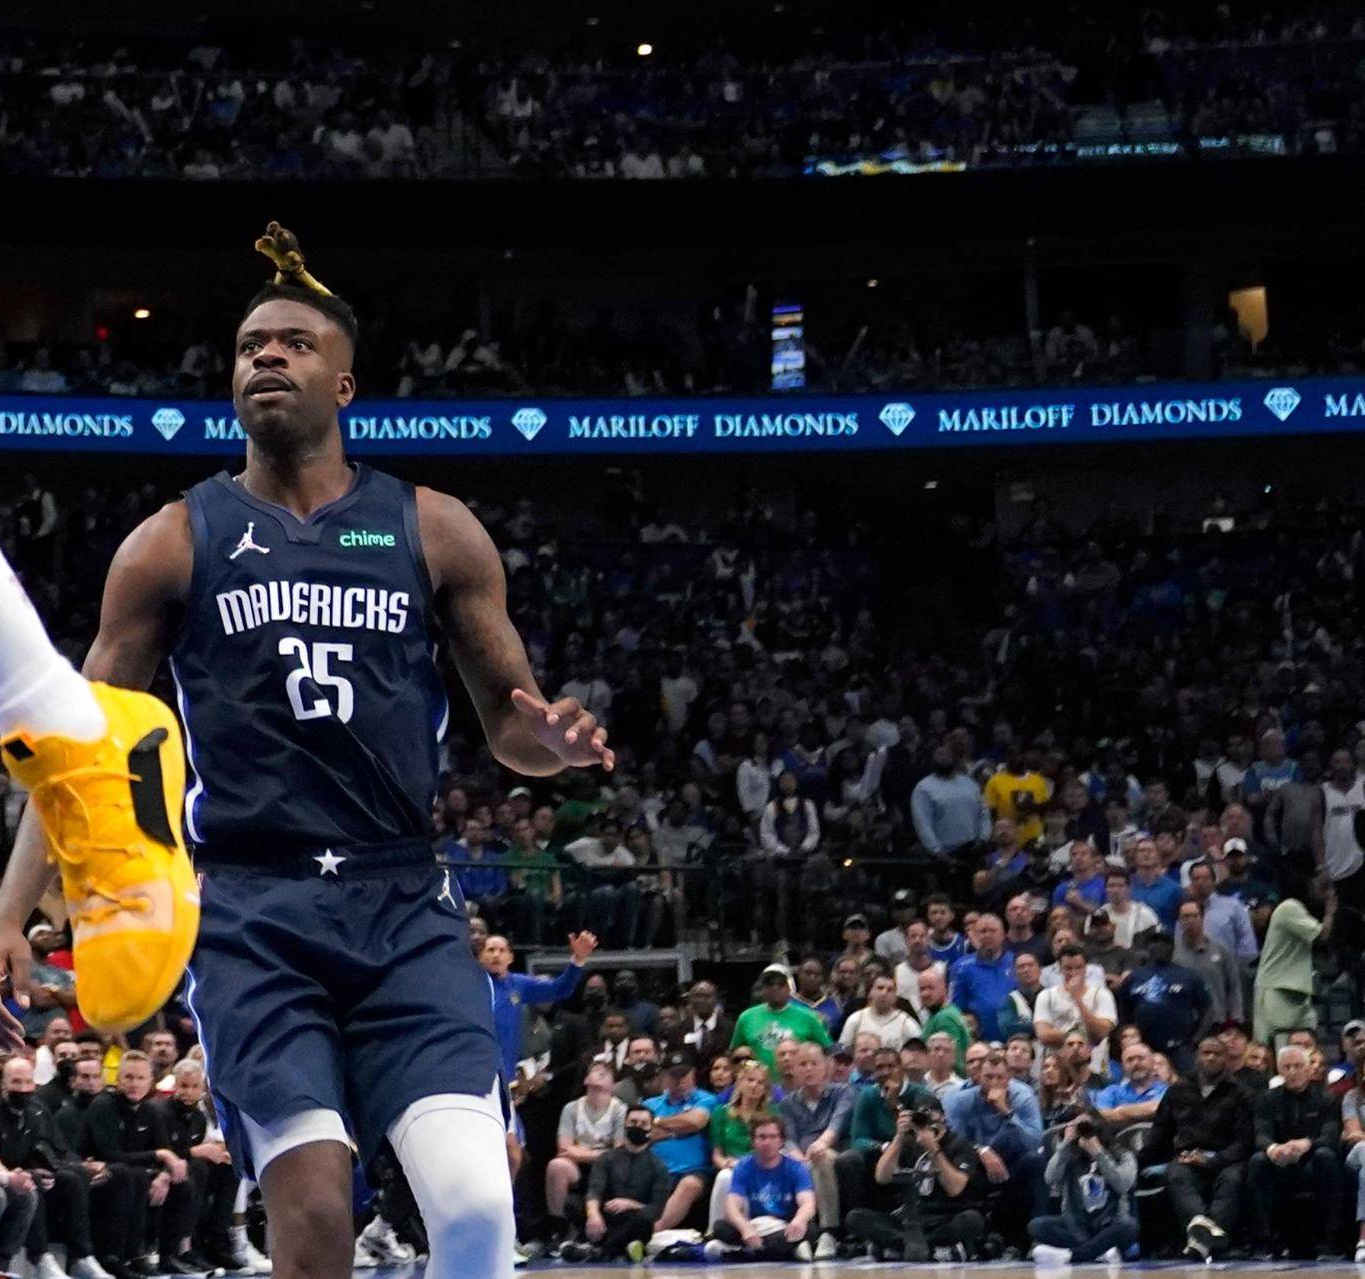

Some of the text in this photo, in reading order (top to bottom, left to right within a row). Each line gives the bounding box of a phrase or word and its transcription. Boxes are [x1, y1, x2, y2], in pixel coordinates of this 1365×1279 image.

[349, 415, 493, 441] DIAMONDS
[568, 411, 859, 439] MARILOFF DIAMONDS
[938, 397, 1243, 432] MARILOFF DIAMONDS
[339, 530, 397, 549] chime
[215, 580, 410, 636] MAVERICKS
[278, 637, 354, 724] 25
